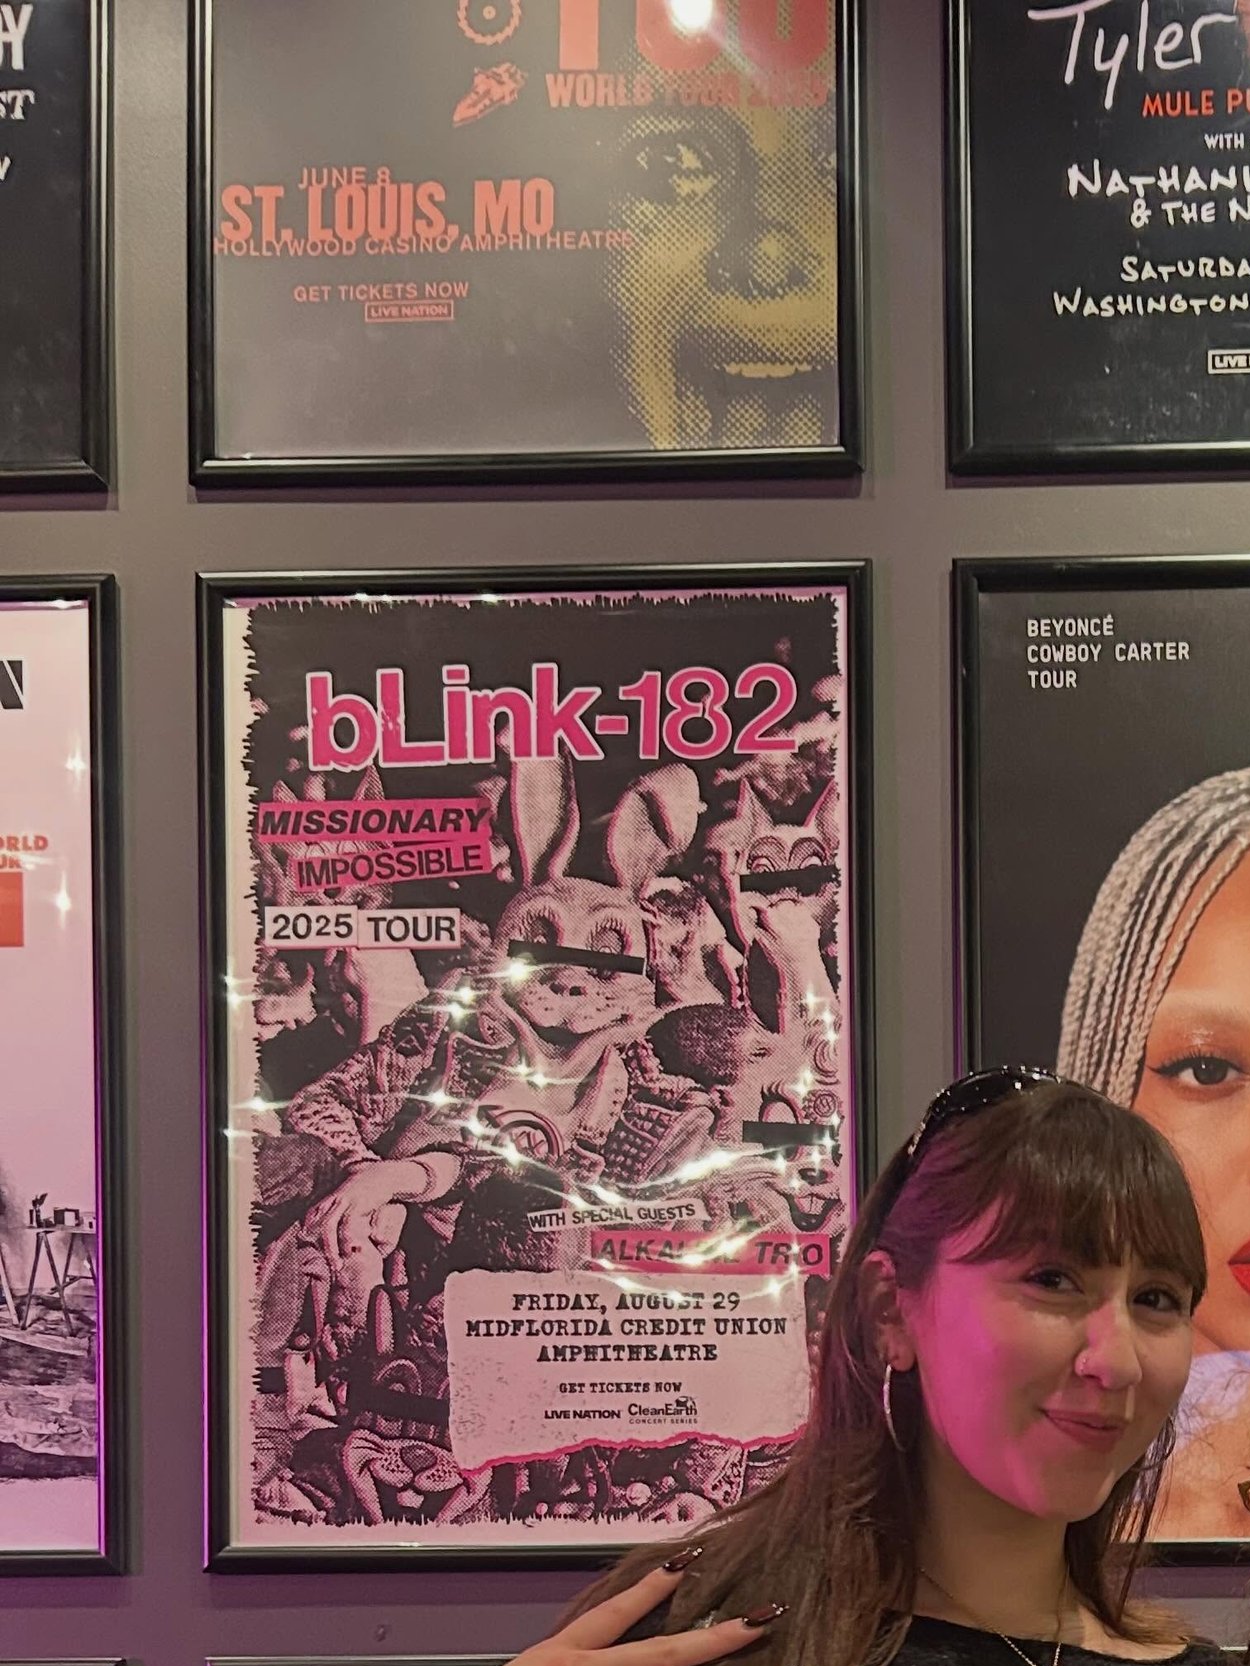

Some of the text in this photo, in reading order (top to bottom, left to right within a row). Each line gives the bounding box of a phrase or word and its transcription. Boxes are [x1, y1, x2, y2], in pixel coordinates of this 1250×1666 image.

[1028, 0, 1238, 110] Tyler
[546, 73, 653, 108] WORLD
[1142, 89, 1214, 118] MULE
[1204, 132, 1245, 150] WITH
[298, 166, 391, 189] JUNE 8
[220, 177, 555, 245] ST. LOUIS, MO
[1130, 198, 1151, 228] &
[1161, 200, 1216, 225] THE
[213, 230, 636, 257] HOLLYWOOD CASINO AMPHITHEATRE
[294, 281, 470, 302] GET TICKETS NOW
[1053, 287, 1250, 318] WASHINGTON
[370, 303, 449, 319] LIVE NATION
[1214, 354, 1247, 369] LIVE
[1026, 613, 1115, 638] BEYONCÉ
[1026, 641, 1191, 665] COWBOY CARTER
[1027, 669, 1077, 690] TOUR
[261, 806, 491, 837] MISSIONARY
[297, 843, 484, 889] IMPOSSIBLE
[271, 912, 459, 945] 2025 TOUR
[528, 1203, 696, 1230] WITH SPECIAL GUESTS
[512, 1291, 741, 1314] FRIDAY, AUGUST 29
[466, 1317, 787, 1338] MIDFLORIDA CREDIT UNION
[536, 1343, 719, 1363] AMPHITHEATRE
[559, 1381, 682, 1394] GET TICKETS NOW
[544, 1409, 622, 1420] LIVE NATION
